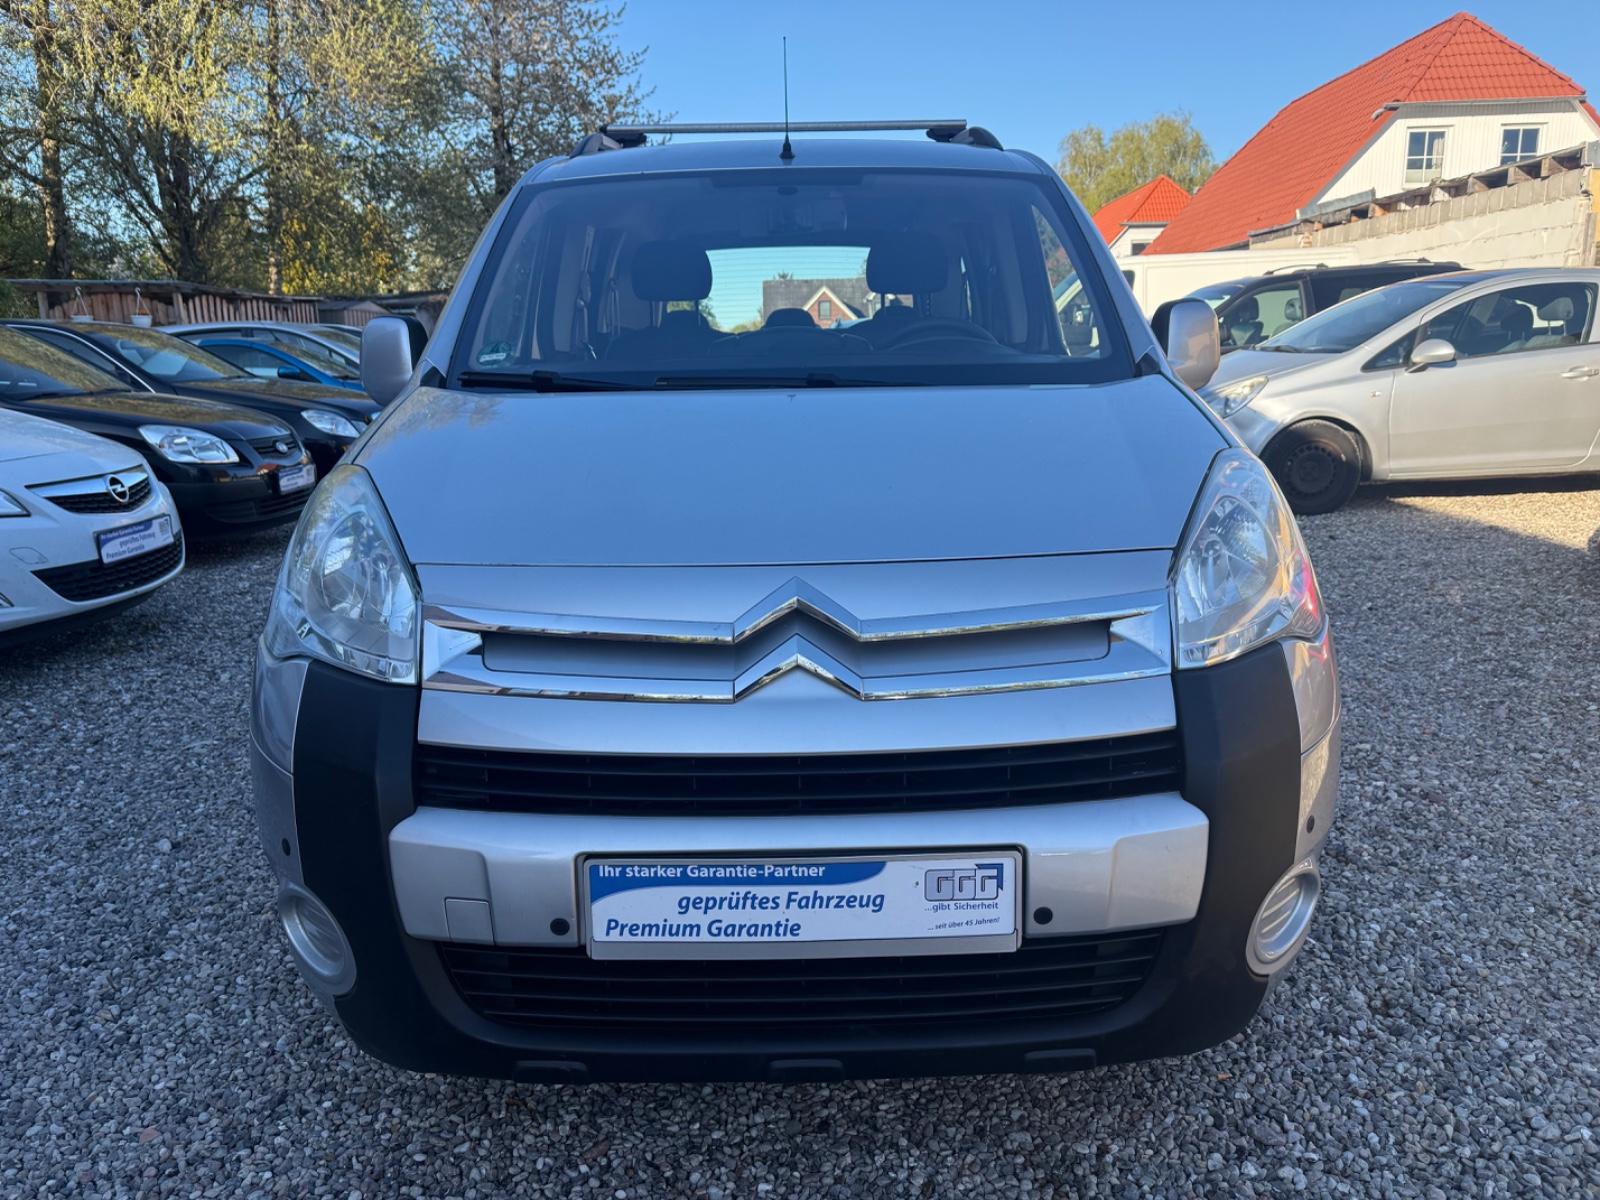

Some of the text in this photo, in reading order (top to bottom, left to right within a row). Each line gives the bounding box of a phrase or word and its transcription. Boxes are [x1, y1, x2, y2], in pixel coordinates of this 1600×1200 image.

[599, 864, 826, 877] Ihr starker Garantie-Partner
[677, 890, 885, 915] geprüftes Fahrzeug
[954, 901, 999, 911] Sicherheit
[605, 918, 801, 937] Premium Garantie
